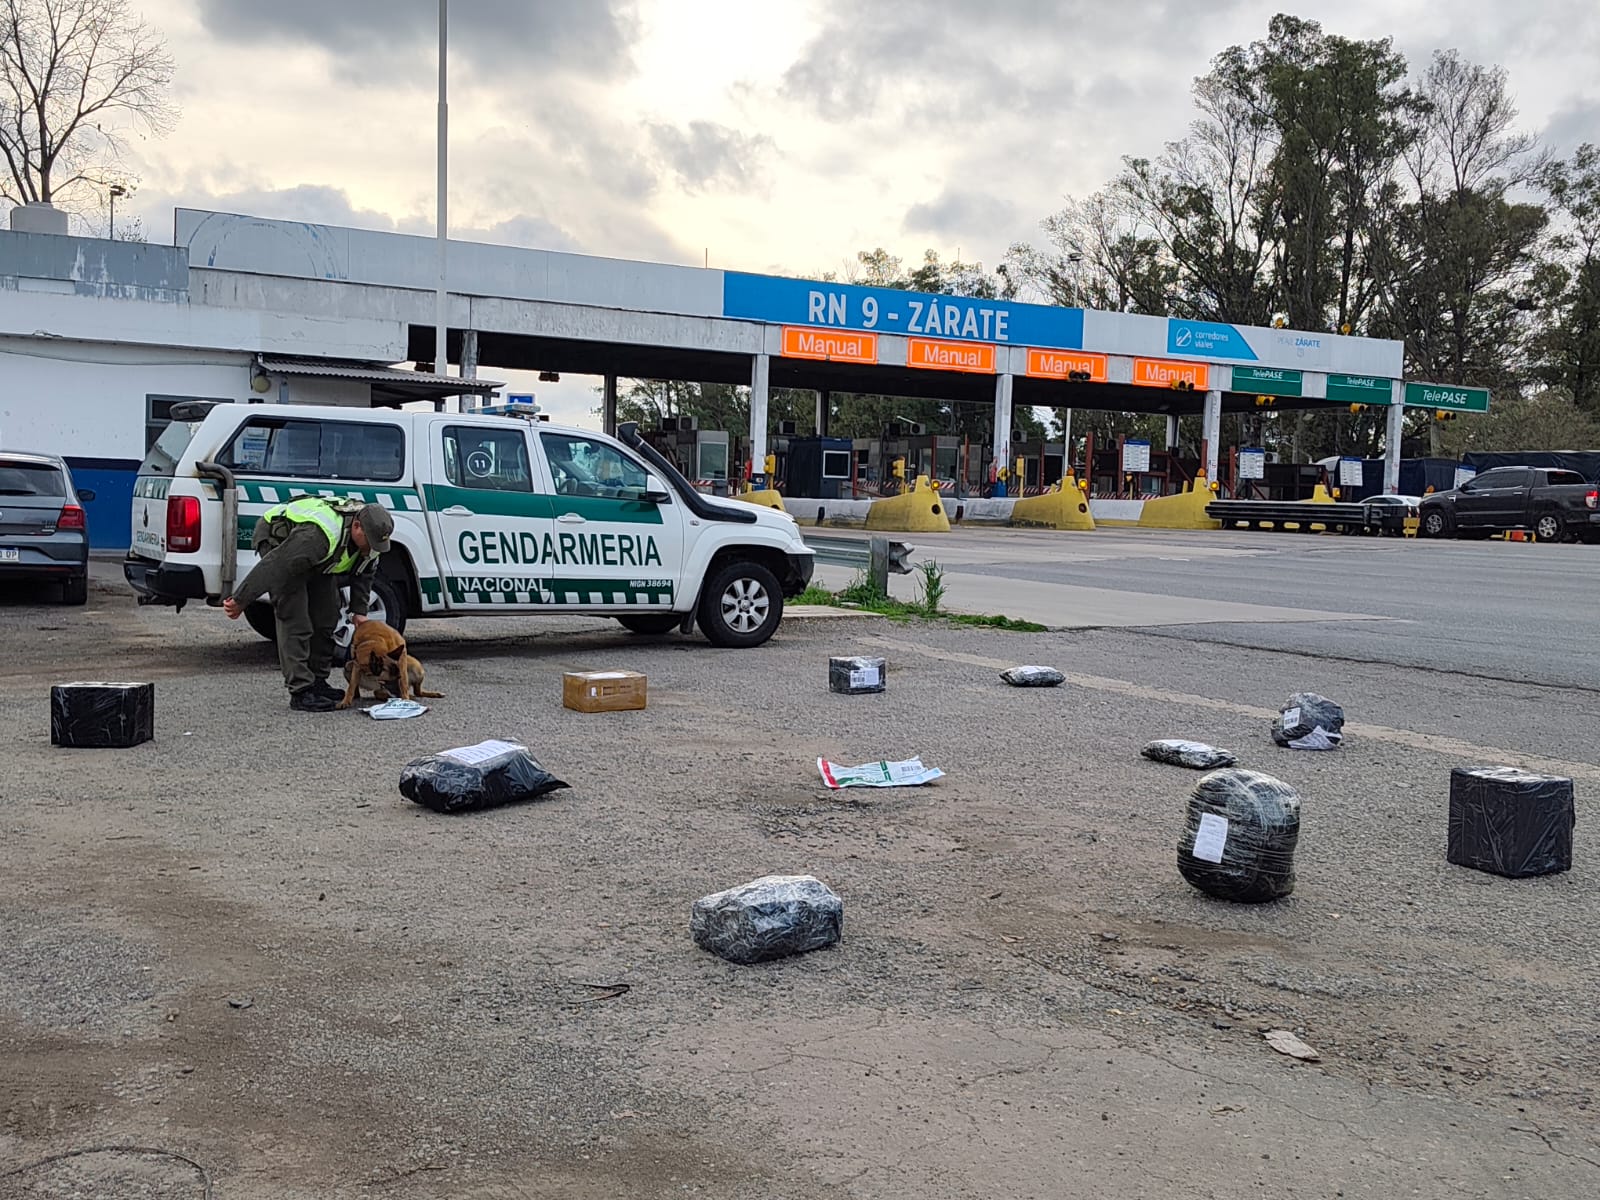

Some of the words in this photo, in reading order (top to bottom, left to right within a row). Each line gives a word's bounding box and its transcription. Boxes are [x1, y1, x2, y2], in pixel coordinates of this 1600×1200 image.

[808, 290, 847, 326] RN
[863, 296, 880, 328] 9
[908, 298, 1010, 341] ZÁRATE
[1195, 331, 1229, 342] corredores
[1295, 337, 1321, 348] ZÁRATE
[798, 334, 863, 358] Manual
[1195, 341, 1214, 349] viales
[924, 344, 982, 367] Manual
[1040, 355, 1094, 377] Manual
[1145, 363, 1196, 385] Manual
[1252, 369, 1284, 380] TelePASE
[1346, 377, 1376, 387] TelePASE
[1422, 389, 1467, 405] TelePASE
[474, 459, 486, 469] 11
[458, 530, 663, 567] GENDARMERIA
[457, 577, 549, 593] NACIONAL
[647, 579, 672, 588] 38694
